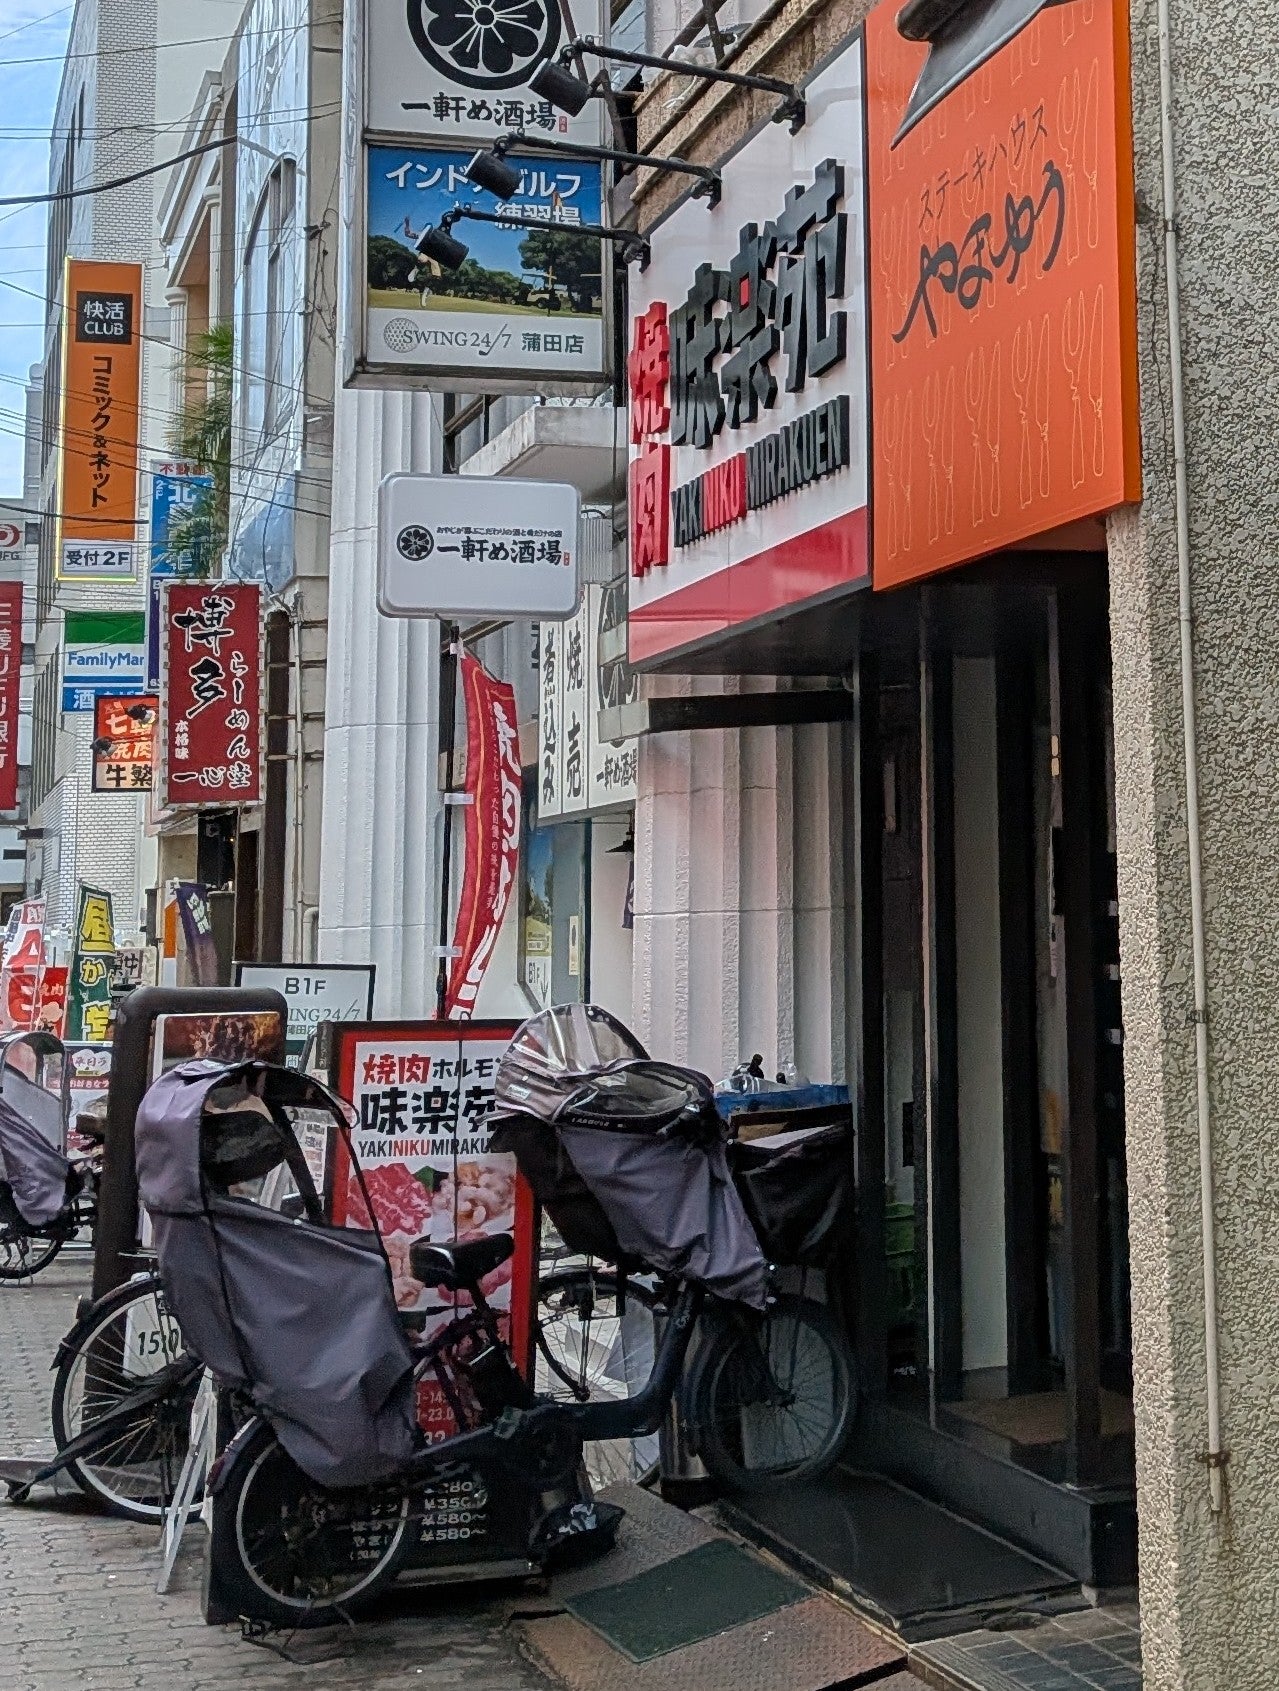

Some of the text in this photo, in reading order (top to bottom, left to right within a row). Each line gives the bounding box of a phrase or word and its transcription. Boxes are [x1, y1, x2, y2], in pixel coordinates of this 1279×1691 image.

[401, 92, 557, 132] 一軒め酒場
[386, 161, 582, 198] インドルフ
[918, 104, 1048, 229] ステーキハウス
[84, 300, 125, 319] 快活
[669, 158, 848, 450] 味楽苑
[84, 321, 124, 336] CLUB
[403, 324, 512, 356] SWING 24/7
[521, 332, 584, 354] 蒲田店
[627, 302, 671, 579] 焼肉
[436, 536, 562, 566] 一軒め酒場
[68, 652, 144, 669] FamilyMar
[172, 595, 236, 719] 博多
[225, 651, 251, 759] らーめん
[105, 763, 152, 788] 牛繁
[172, 761, 252, 789] 一心堂
[284, 977, 327, 995] B1F
[358, 1139, 493, 1158] YAKINIKUMIRAKU
